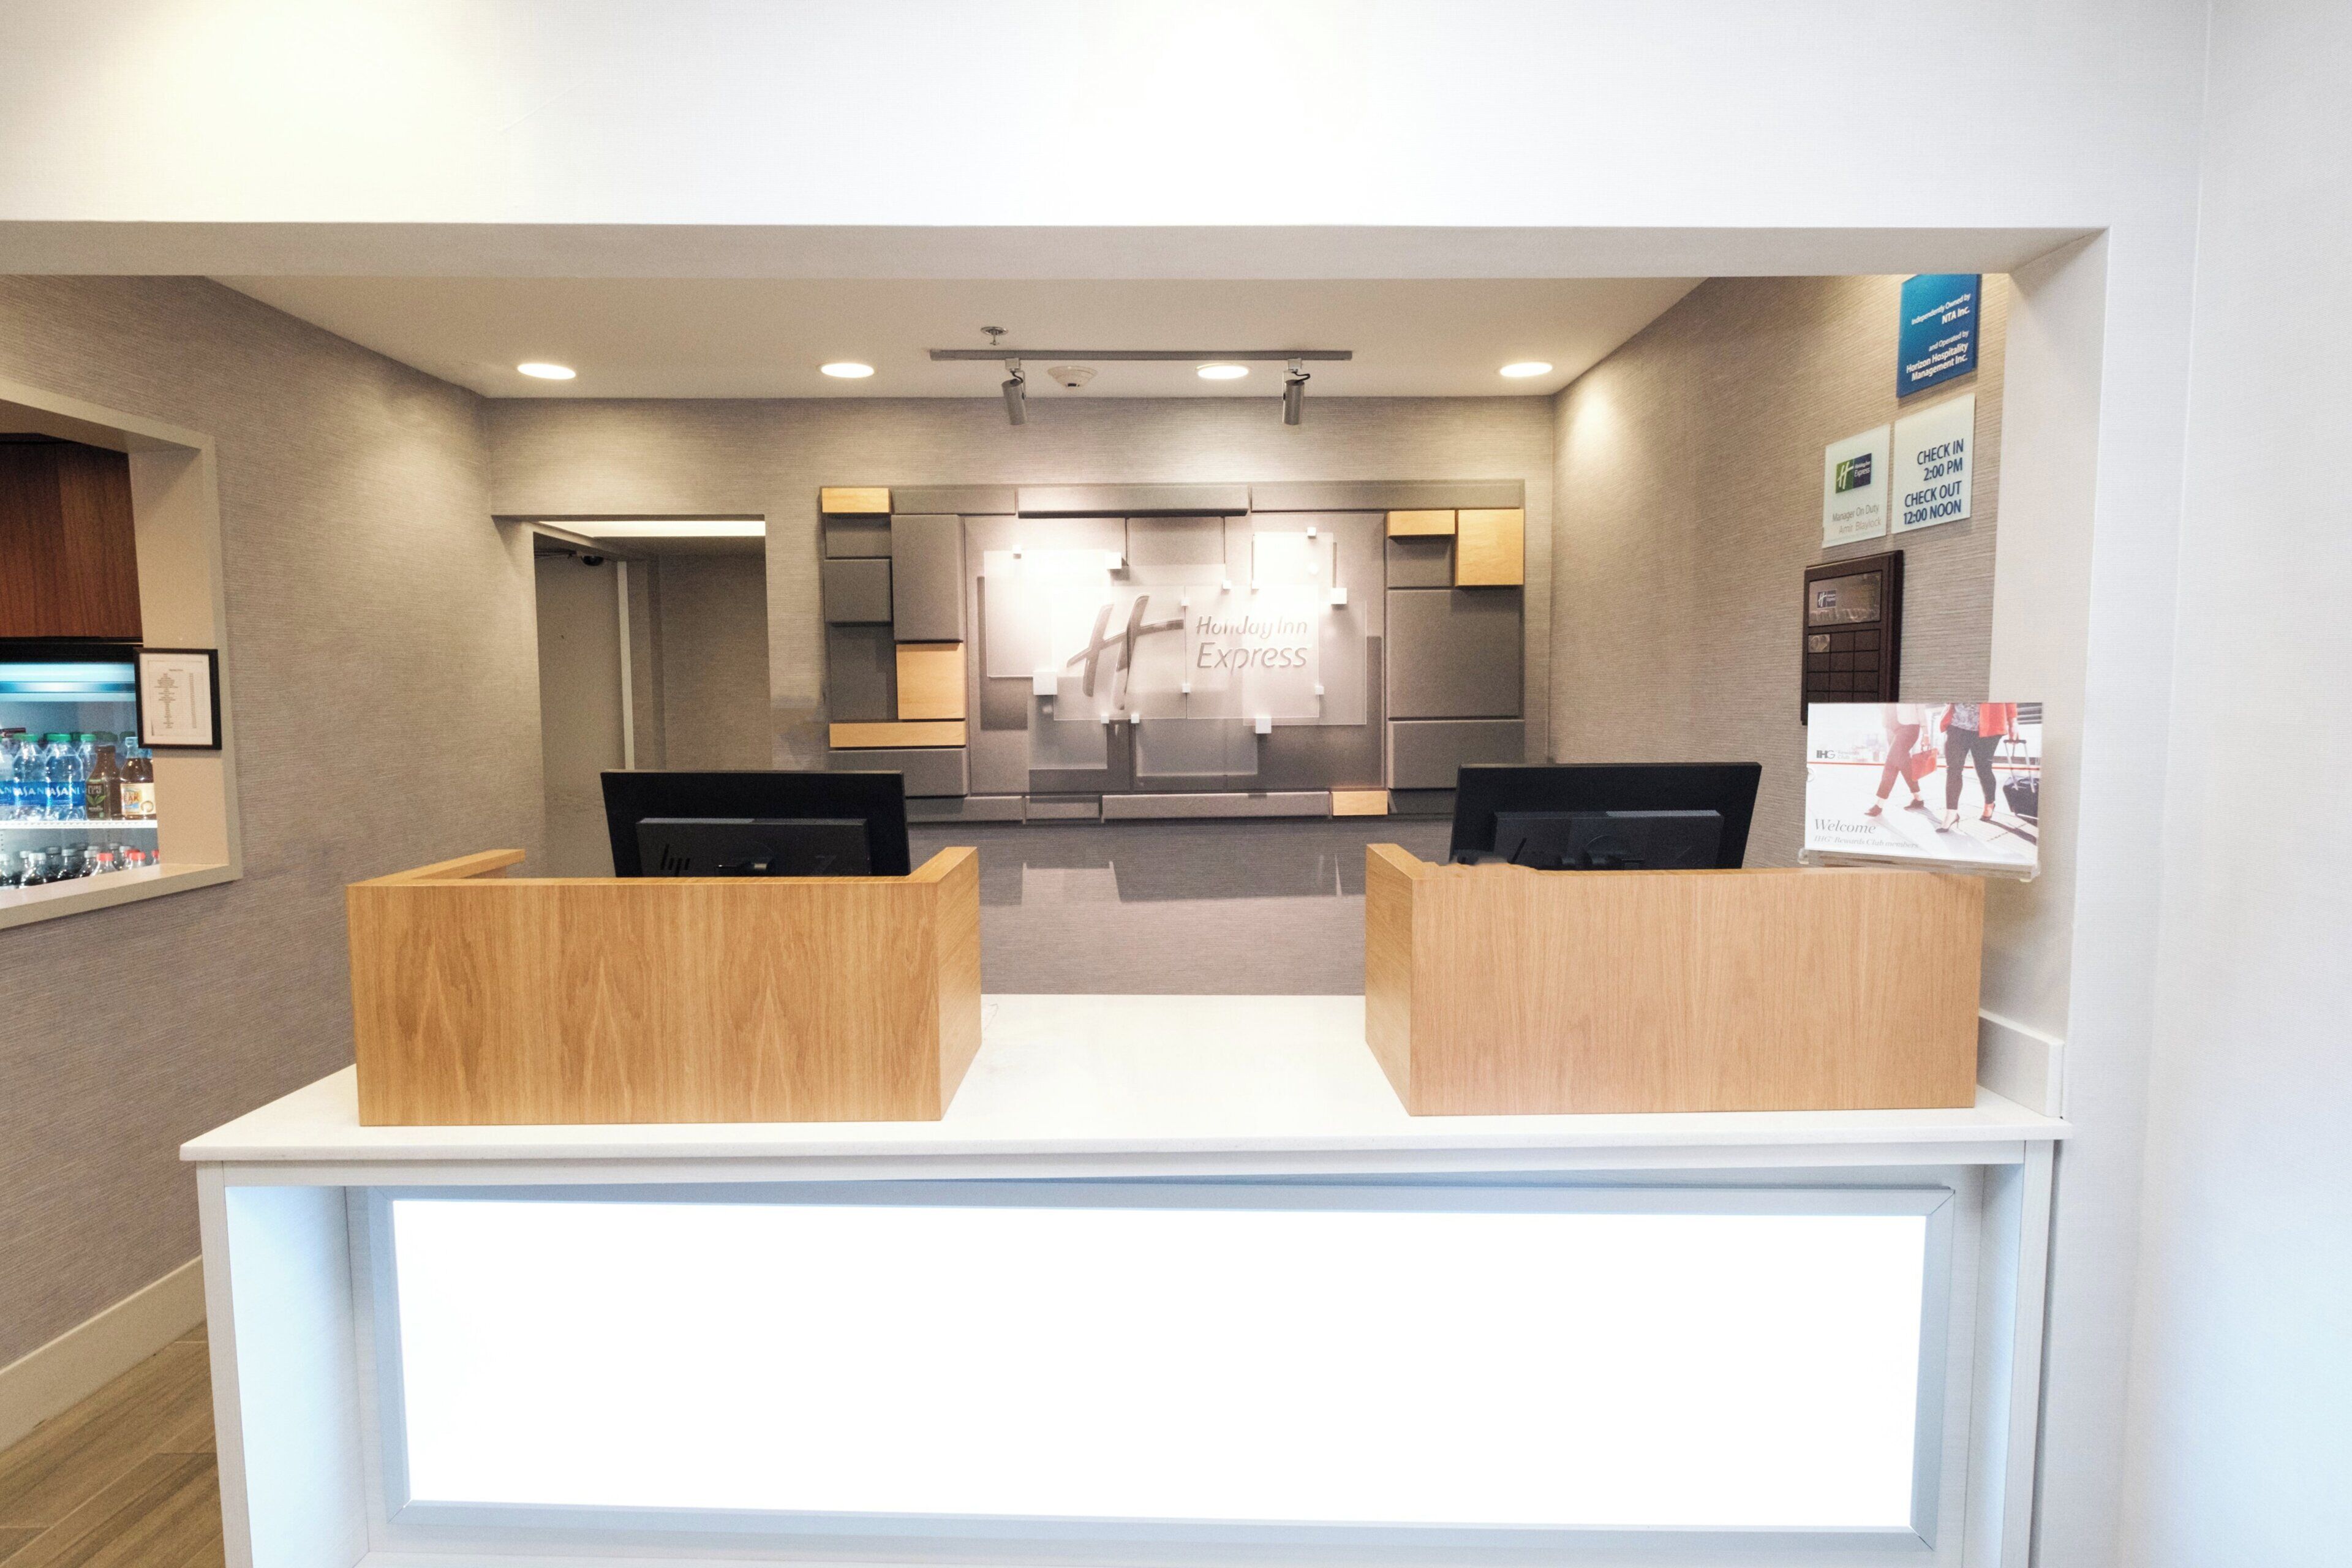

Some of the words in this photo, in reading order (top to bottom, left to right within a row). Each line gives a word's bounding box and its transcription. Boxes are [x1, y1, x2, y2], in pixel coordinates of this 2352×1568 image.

[1911, 305, 1945, 325] Independently
[1945, 295, 1963, 309] Owned
[1964, 293, 1971, 301] by
[1942, 311, 1956, 325] NTA
[1958, 306, 1970, 317] Inc.
[1929, 342, 1939, 352] and
[1939, 332, 1962, 348] Operated
[1906, 358, 1931, 373] Horizon
[1932, 343, 1969, 364] Hospitality
[1911, 358, 1954, 382] Management
[1955, 354, 1968, 364] Inc.
[1917, 442, 1950, 465] CHECK
[1953, 438, 1964, 454] IN
[1855, 467, 1871, 477] Express
[1923, 463, 1944, 481] 2:00
[1947, 457, 1963, 475] PM
[1904, 487, 1937, 507] CHECK
[1939, 480, 1962, 499] OUT
[1832, 510, 1855, 521] Manager
[1856, 507, 1864, 517] On
[1866, 504, 1880, 514] Duty
[1903, 508, 1928, 525] 12:00
[1929, 499, 1961, 519] NOON
[1196, 615, 1273, 639] Holiday
[1277, 615, 1308, 635] Inn
[1196, 641, 1308, 675] Express
[1816, 750, 1836, 759] IHG
[1814, 818, 1876, 834] Welcome
[1834, 837, 1865, 845] Rewards
[1866, 838, 1883, 846] Club
